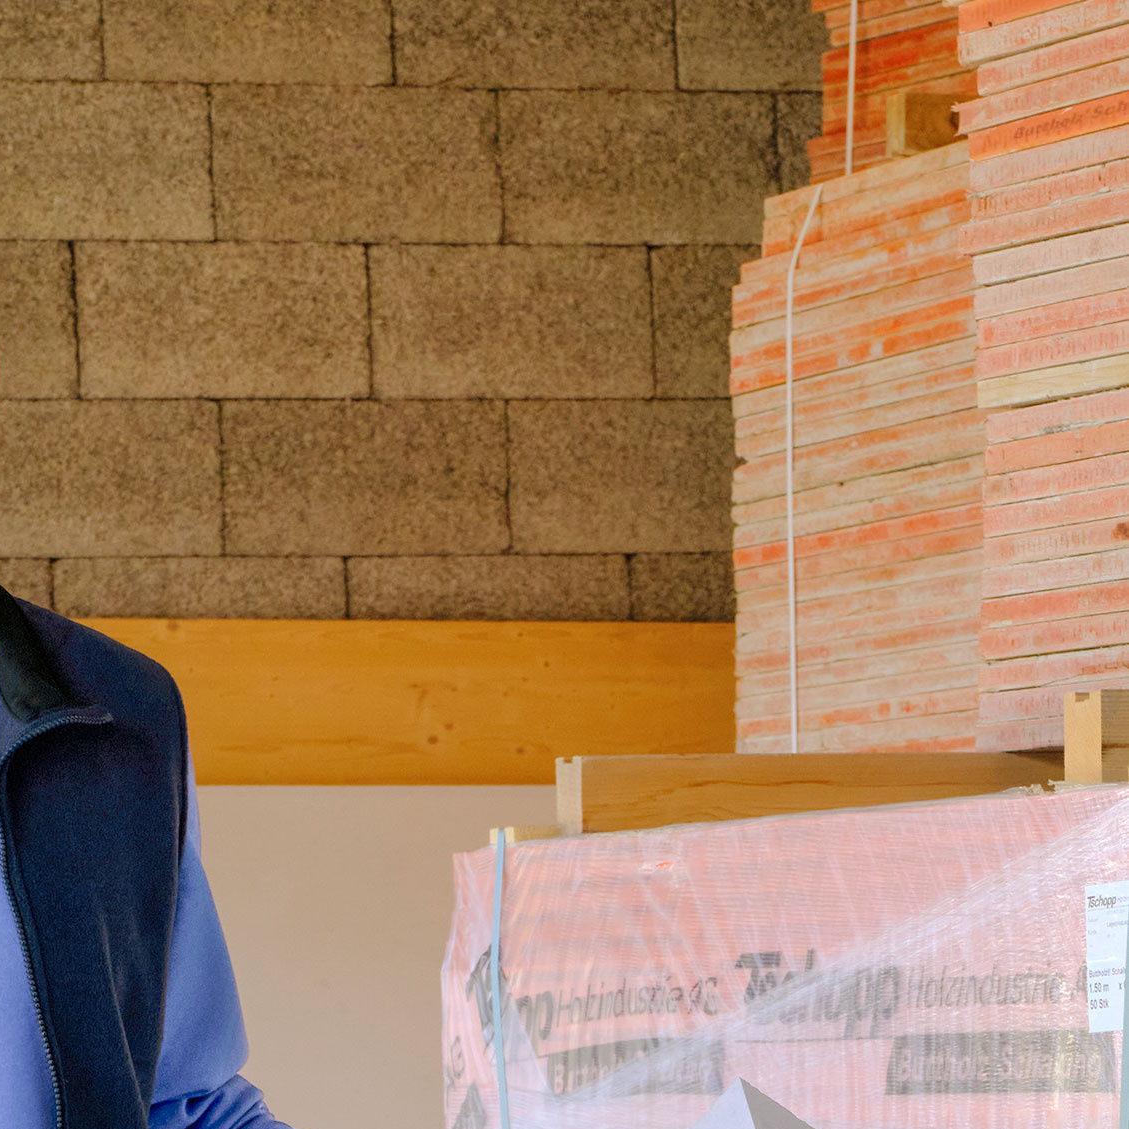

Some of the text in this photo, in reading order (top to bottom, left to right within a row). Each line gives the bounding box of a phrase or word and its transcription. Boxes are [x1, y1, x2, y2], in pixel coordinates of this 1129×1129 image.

[1087, 895, 1117, 909] Tschopp
[1090, 997, 1110, 1010] 50 Stk
